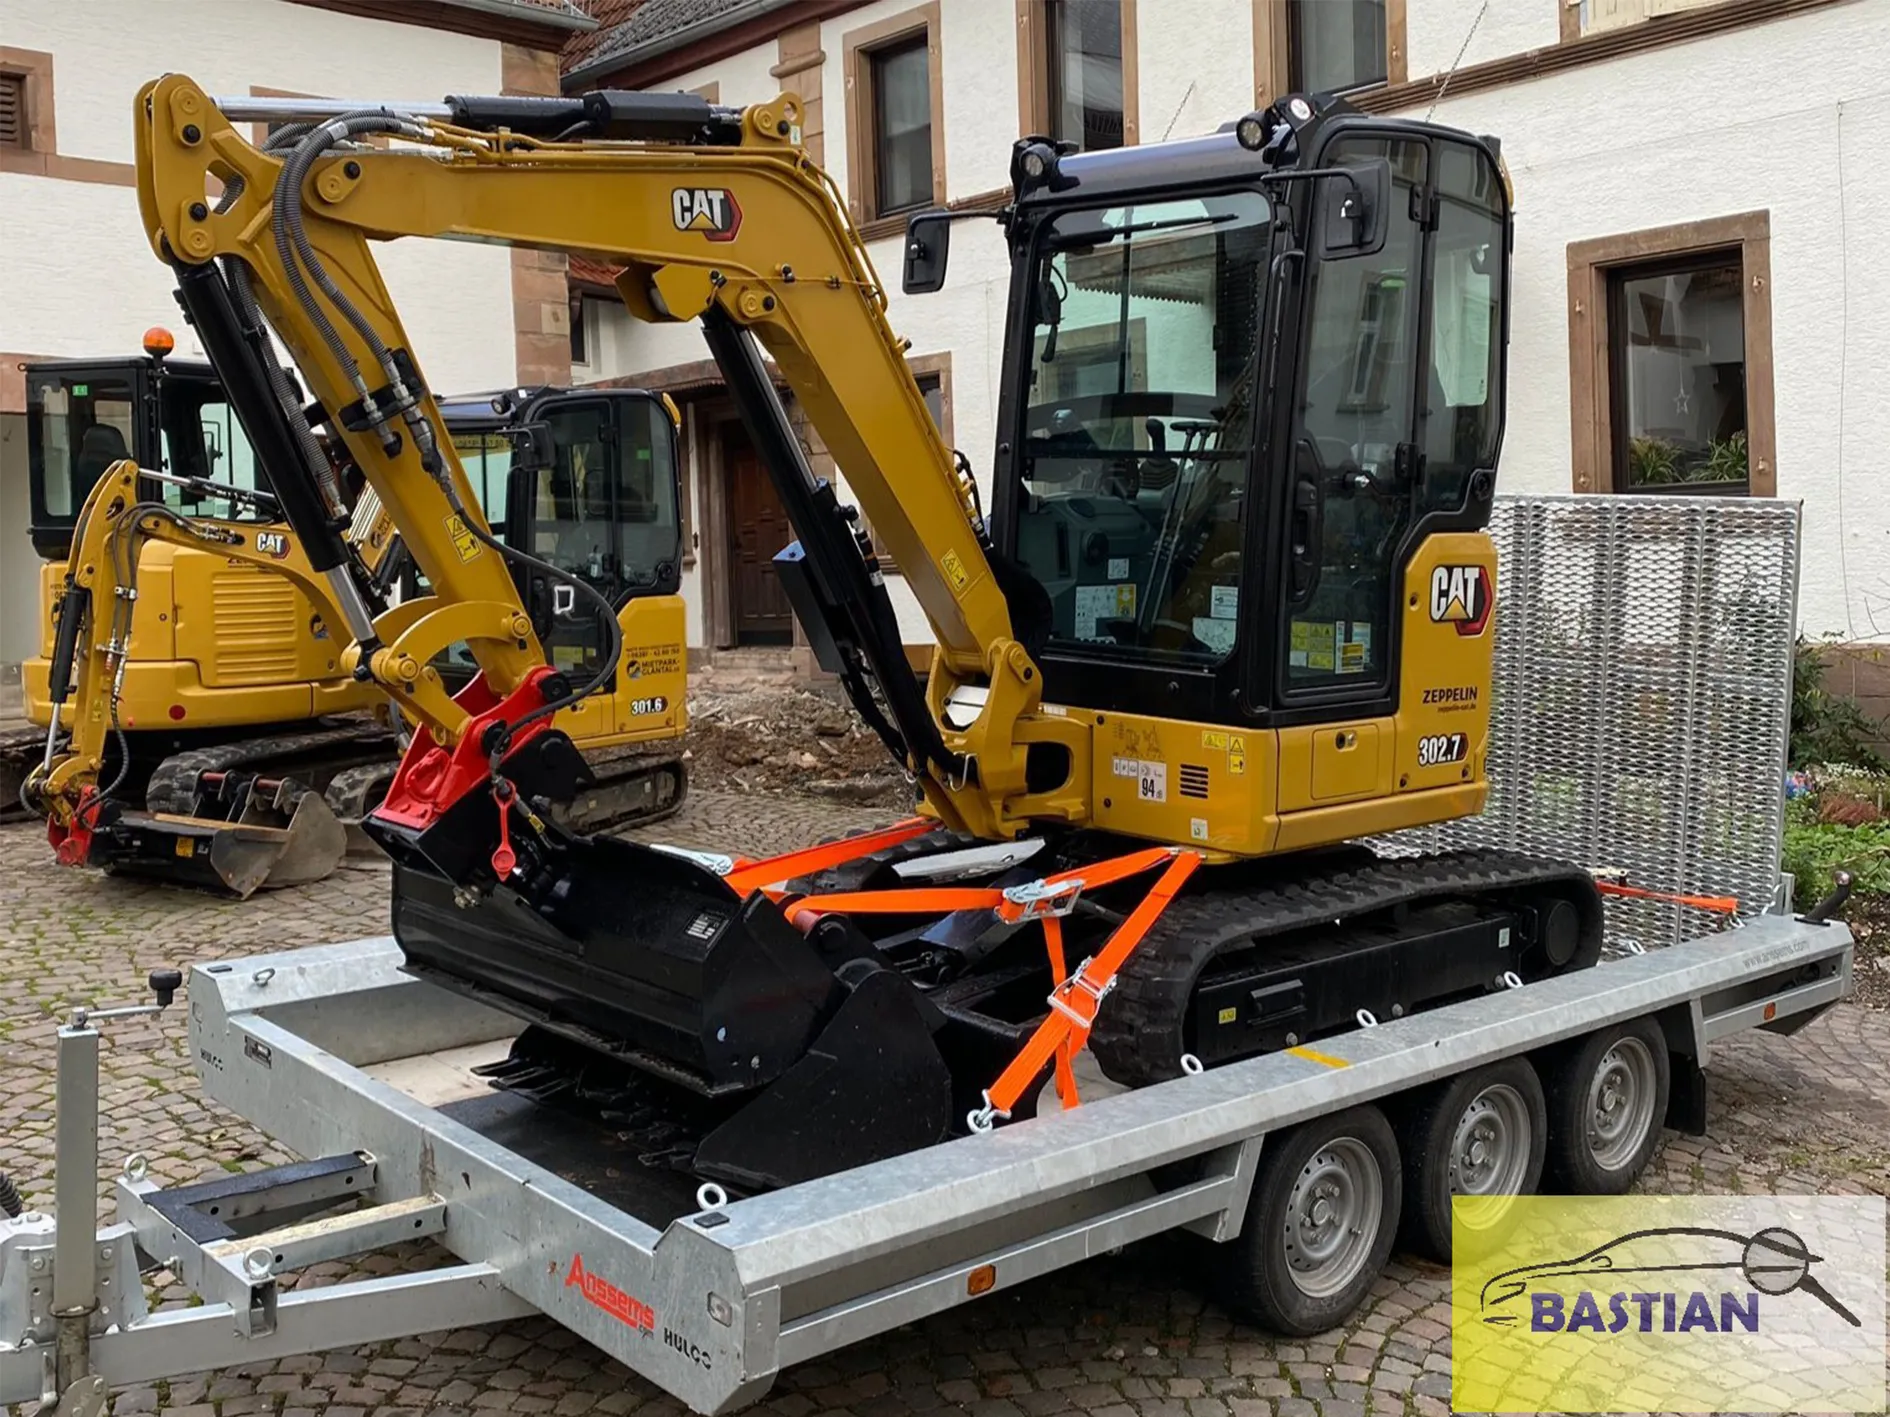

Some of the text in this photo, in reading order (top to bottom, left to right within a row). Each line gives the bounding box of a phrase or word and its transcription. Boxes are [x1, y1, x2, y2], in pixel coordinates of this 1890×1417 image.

[672, 188, 725, 230] CAT
[257, 532, 284, 553] CAT
[1430, 566, 1480, 621] CAT
[631, 697, 663, 716] 301.6
[1423, 687, 1478, 704] ZEPPELIN
[1418, 735, 1461, 766] 302.7
[1141, 777, 1156, 798] 94
[663, 1327, 712, 1371] HULCO
